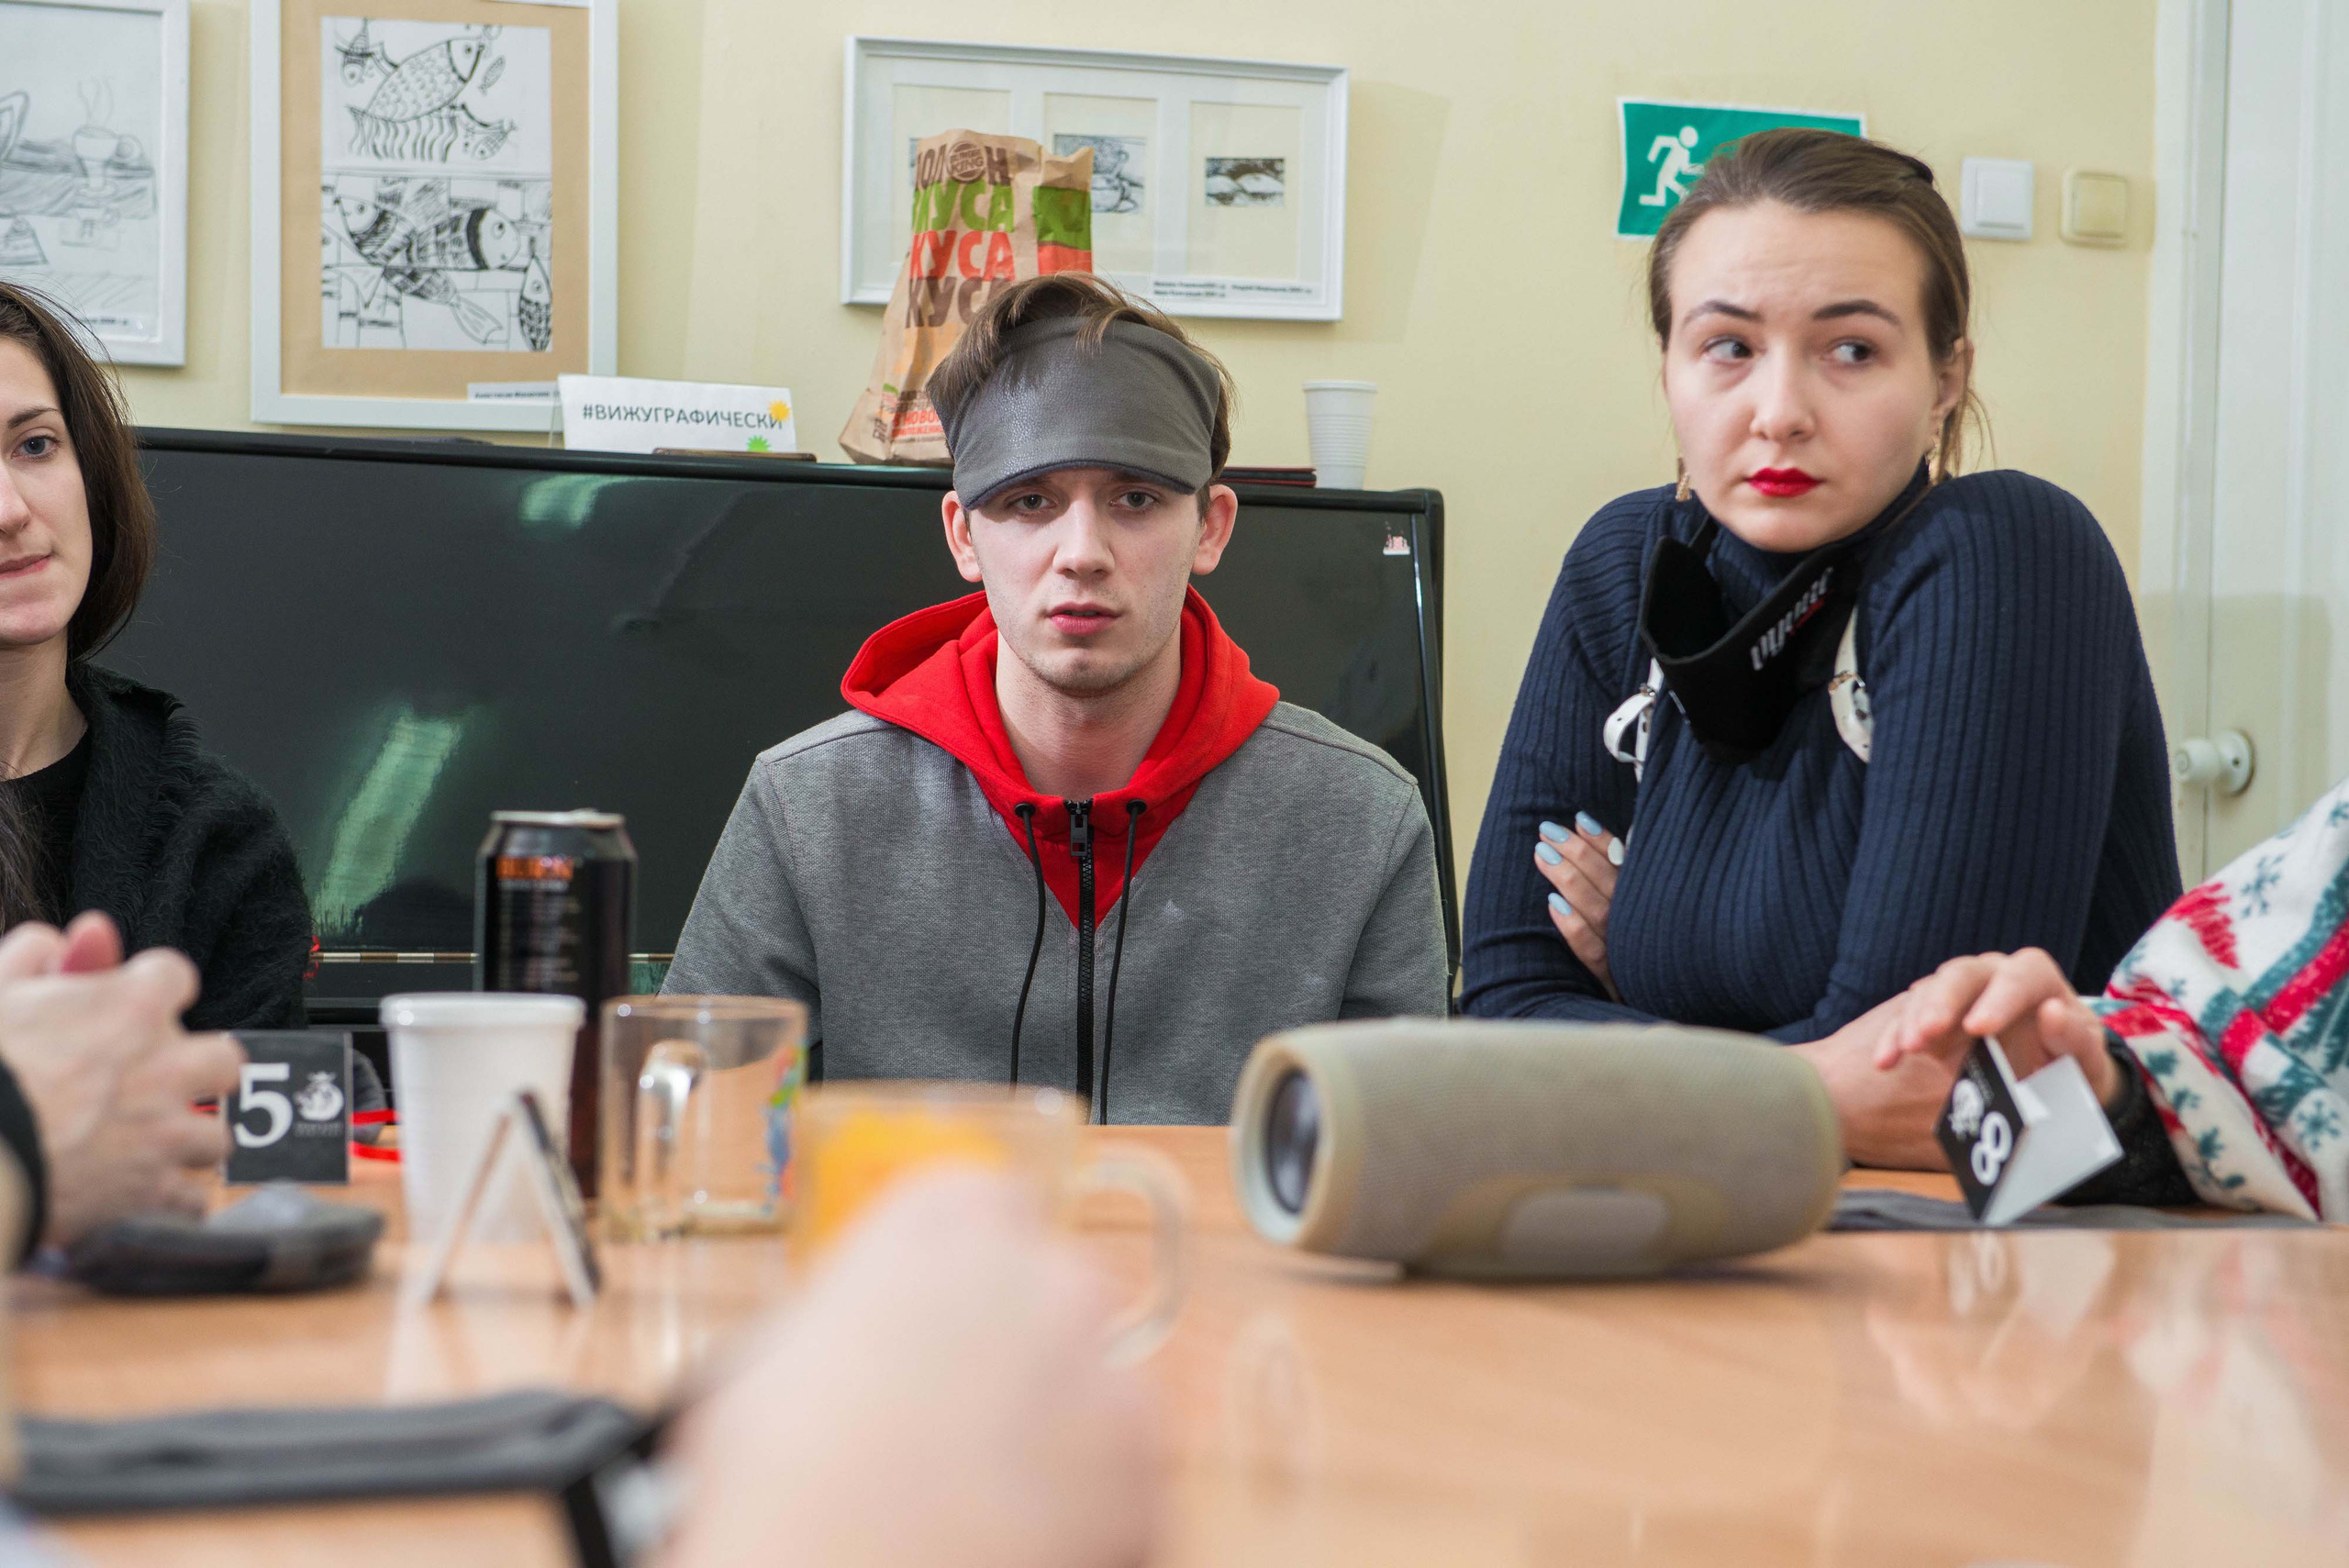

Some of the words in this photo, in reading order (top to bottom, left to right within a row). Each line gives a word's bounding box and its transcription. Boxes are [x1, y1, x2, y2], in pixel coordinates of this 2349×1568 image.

[951, 156, 985, 173] KING
[582, 403, 784, 430] #ВИЖУГРАФИЧЕСКИ
[233, 1062, 294, 1148] 5
[1970, 1110, 2014, 1185] 8
